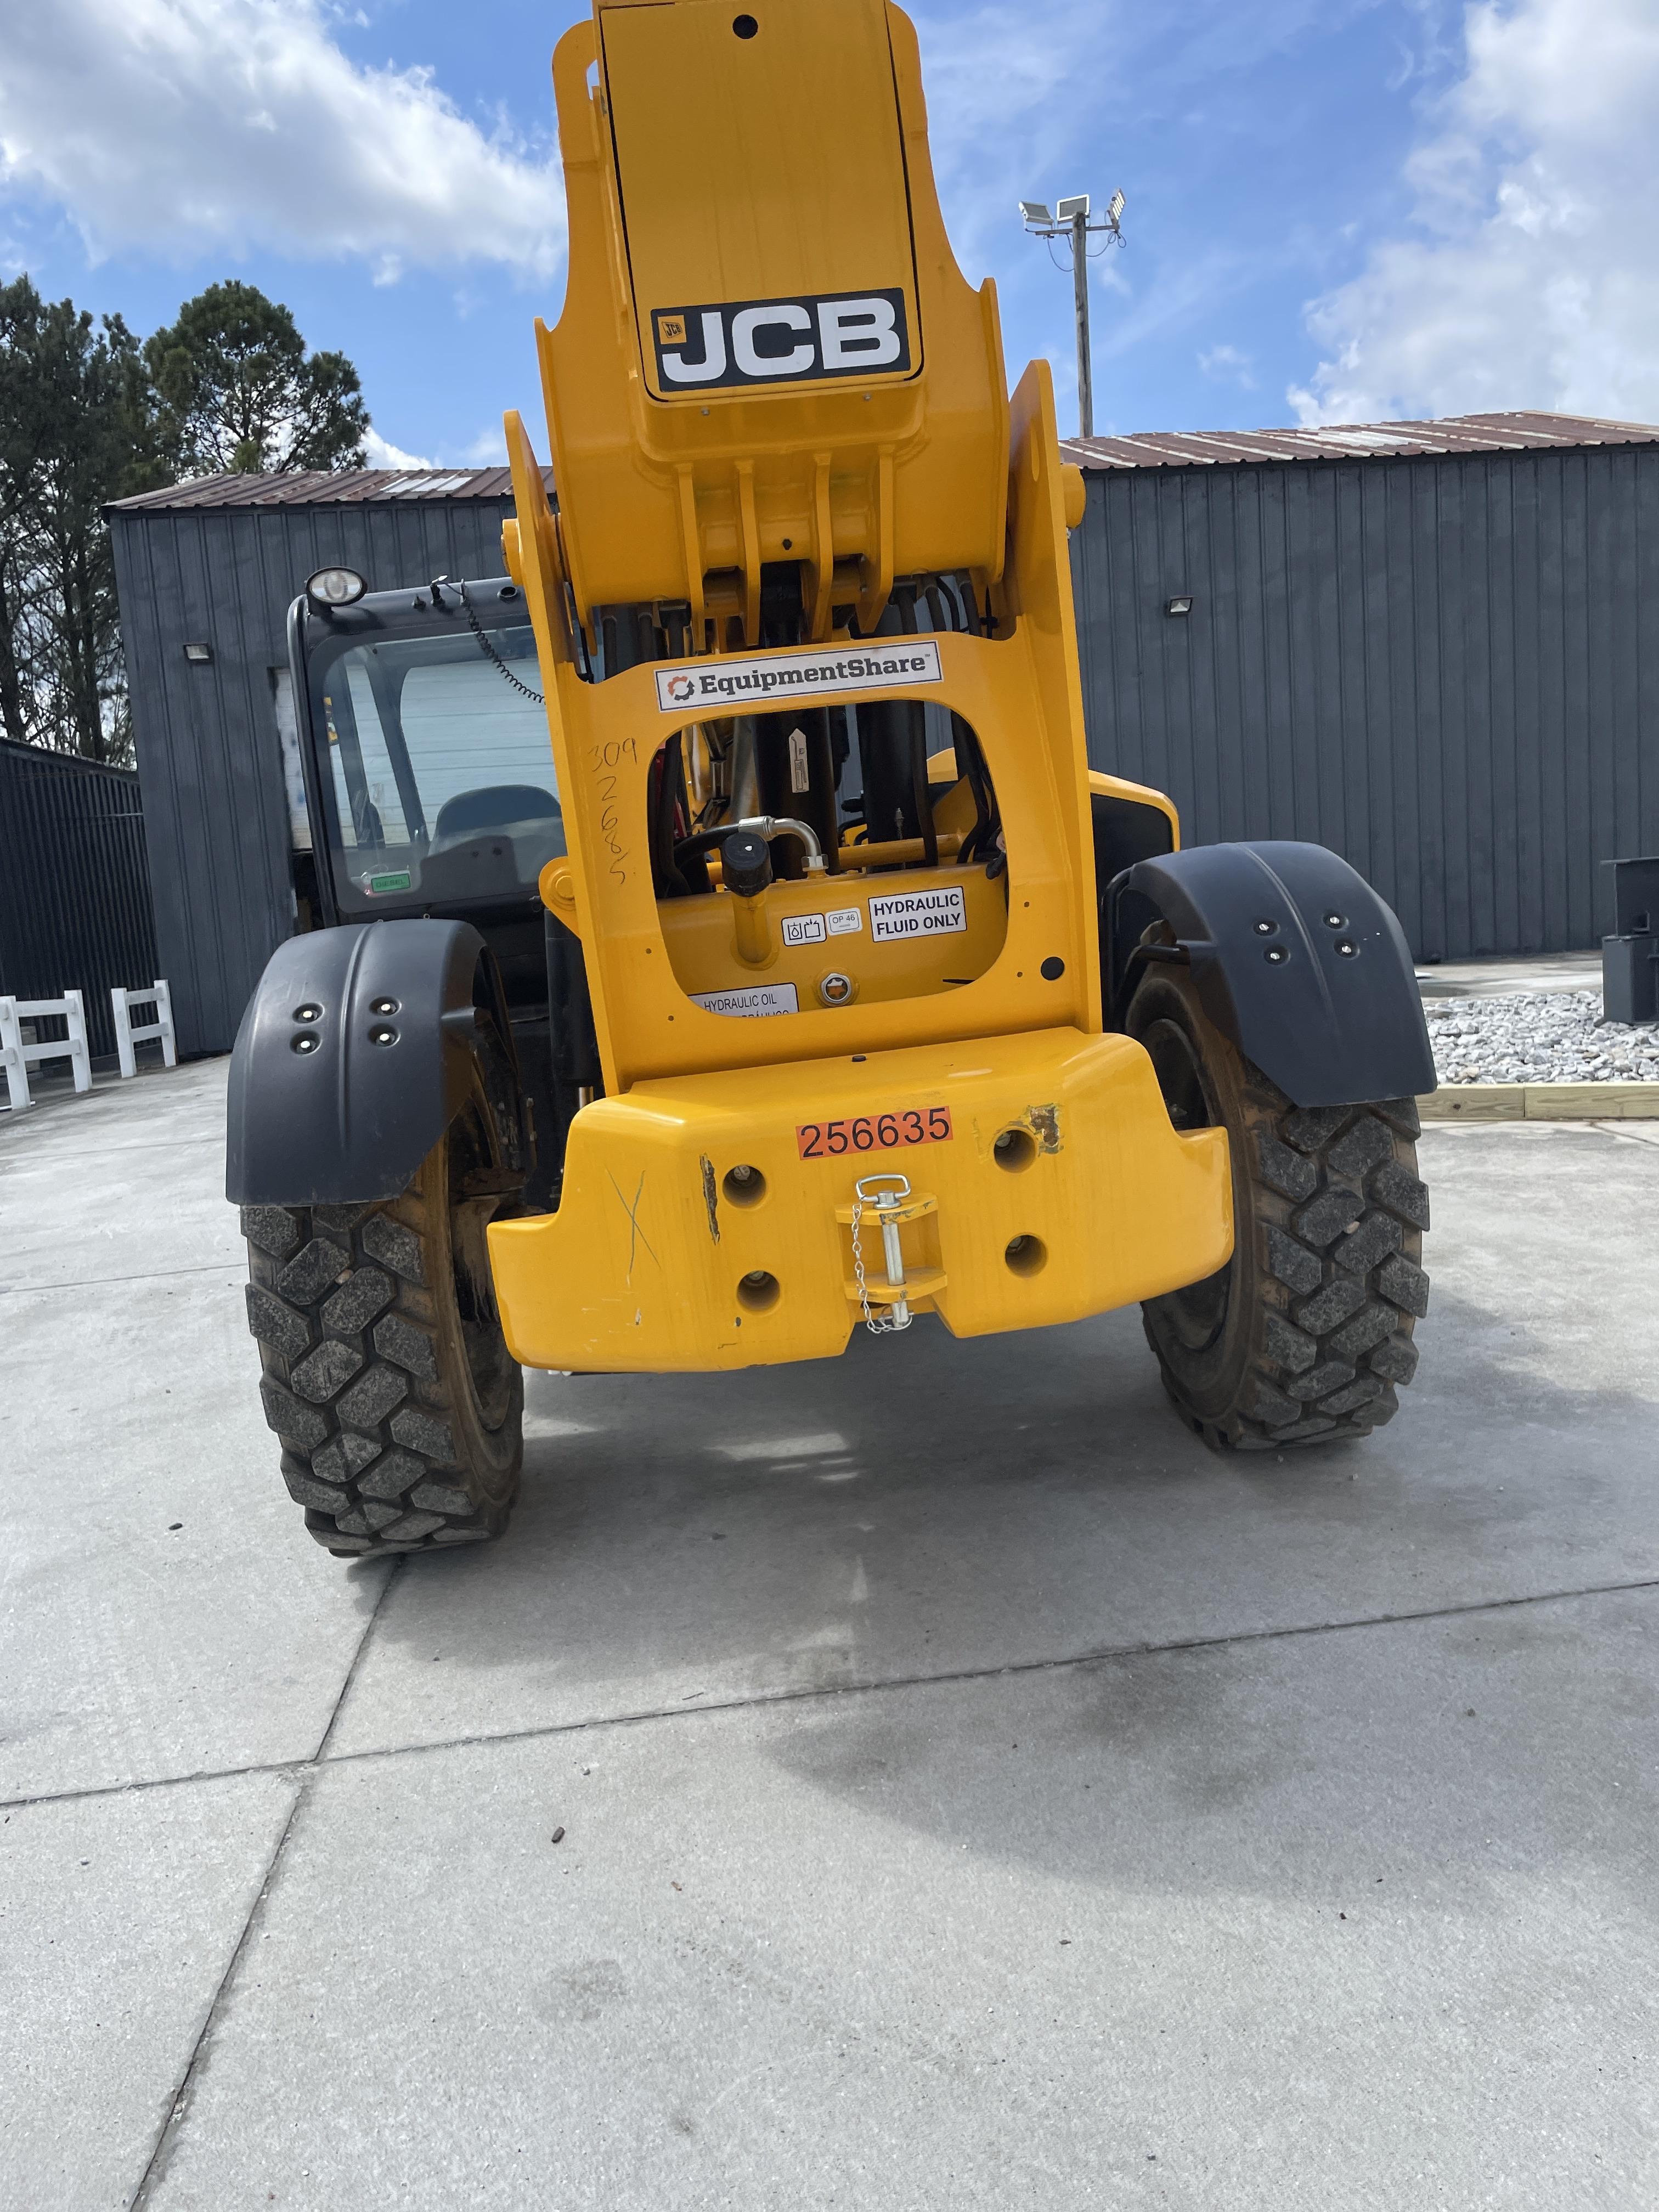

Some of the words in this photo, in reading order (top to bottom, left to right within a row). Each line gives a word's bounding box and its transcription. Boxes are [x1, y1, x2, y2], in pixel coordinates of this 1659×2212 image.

[662, 297, 901, 382] JCB
[665, 324, 681, 336] JCB
[588, 737, 637, 772] 309
[375, 879, 406, 888] DIESEL
[874, 894, 960, 916] HYDRAULIC
[832, 916, 844, 924] OP
[877, 918, 918, 935] FLUID
[923, 913, 961, 929] ONLY
[704, 995, 759, 1012] HYDRAULIC
[761, 993, 777, 1005] OIL
[800, 1108, 950, 1158] 256635
